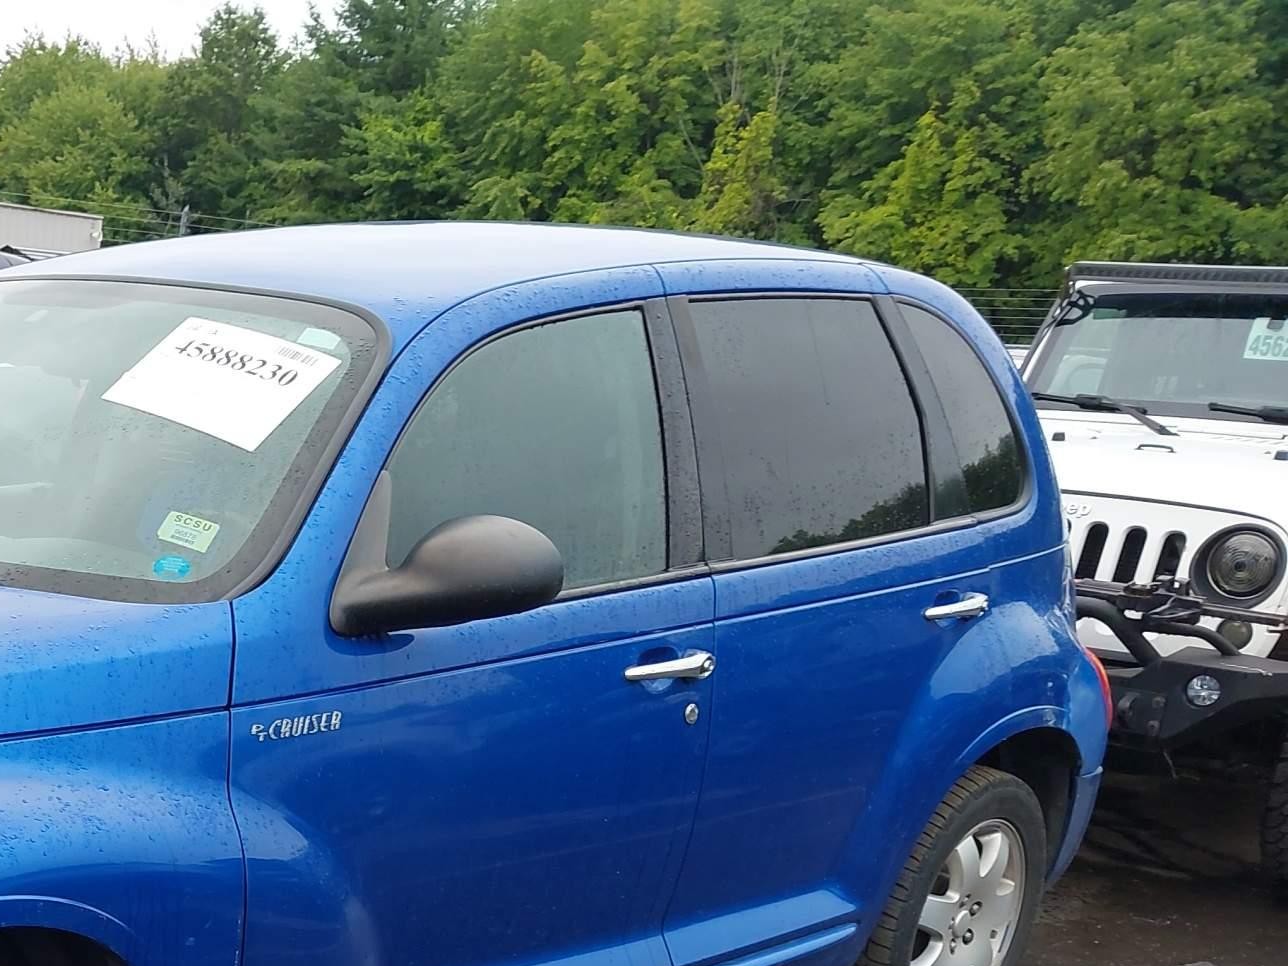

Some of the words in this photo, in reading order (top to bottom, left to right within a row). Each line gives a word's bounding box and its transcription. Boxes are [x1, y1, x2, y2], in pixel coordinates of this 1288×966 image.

[175, 340, 299, 386] 45888230
[174, 514, 212, 531] SCSU
[268, 710, 342, 739] CRUISER
